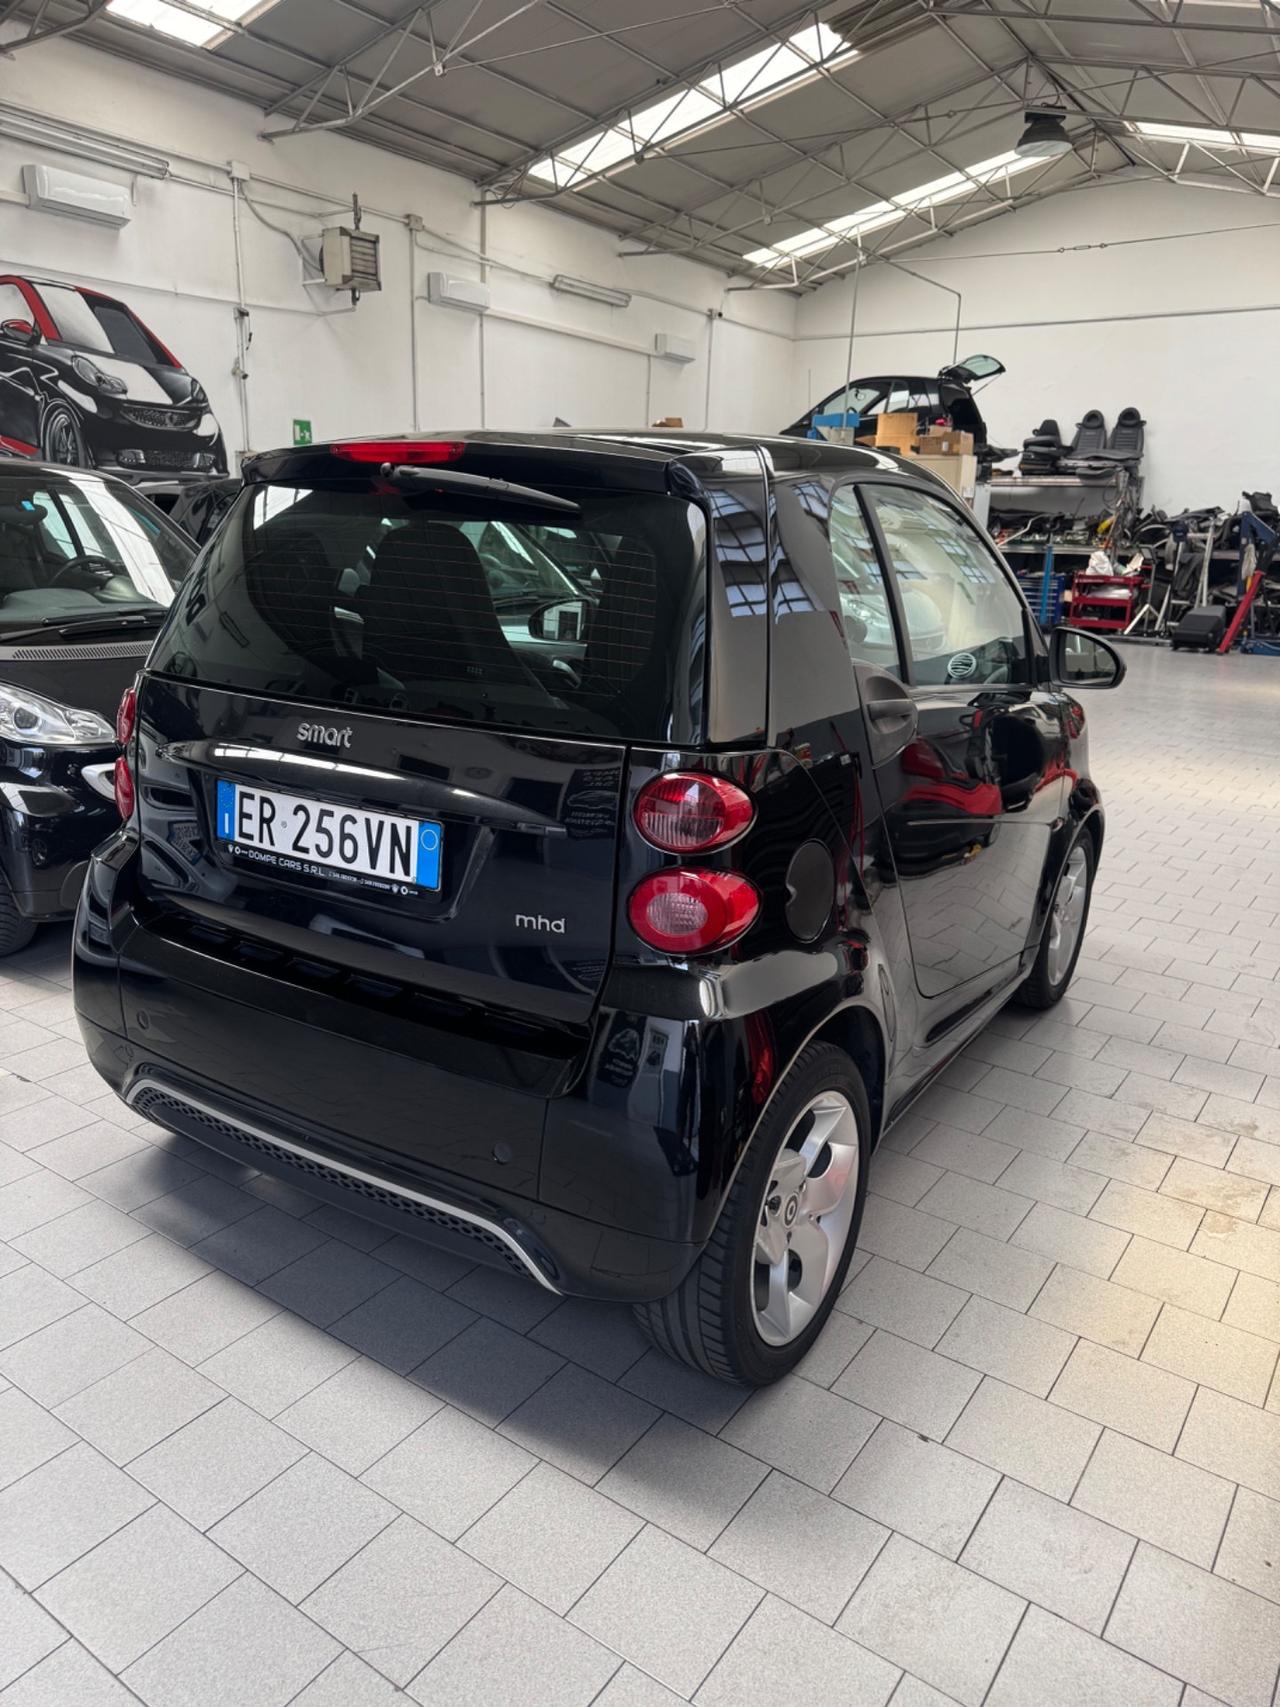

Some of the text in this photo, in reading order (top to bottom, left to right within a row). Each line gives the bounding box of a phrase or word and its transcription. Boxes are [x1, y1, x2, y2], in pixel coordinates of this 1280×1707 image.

[297, 722, 353, 748] smart
[278, 858, 302, 871] CARS
[515, 913, 566, 934] mhd
